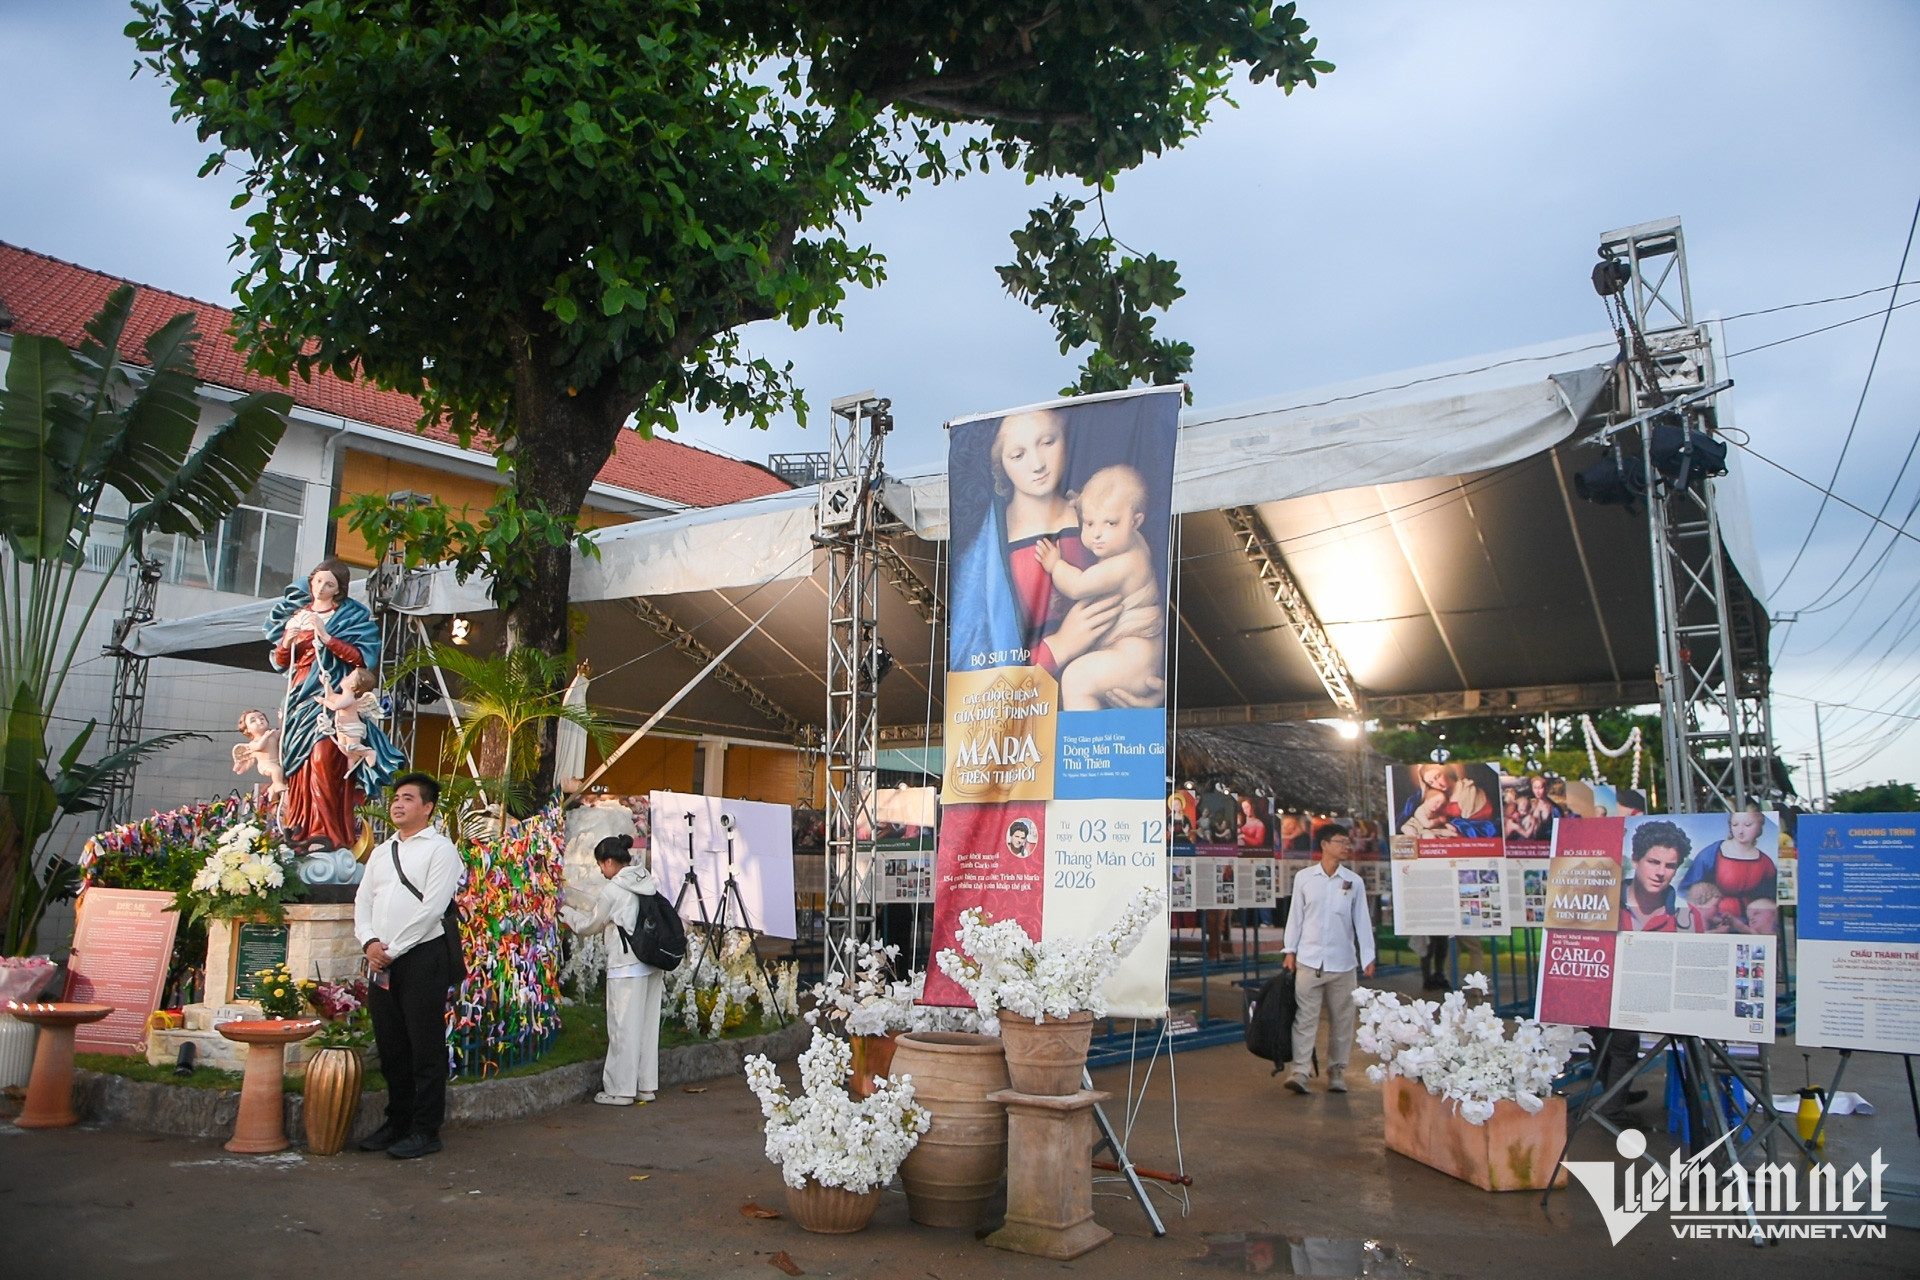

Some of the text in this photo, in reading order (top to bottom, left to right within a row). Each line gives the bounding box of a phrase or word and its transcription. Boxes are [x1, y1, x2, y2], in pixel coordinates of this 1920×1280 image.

[970, 652, 986, 666] BỘ
[1010, 648, 1031, 661] TẬP
[1063, 742, 1165, 758] Dòng Mến Thánh Giá
[1062, 758, 1081, 770] Thủ
[960, 770, 991, 785] TRÊN
[1079, 819, 1107, 843] 03
[1114, 820, 1130, 830] đến
[1141, 820, 1163, 844] 12
[1055, 850, 1155, 869] Tháng Mân Côi
[1054, 870, 1096, 889] 2026
[1552, 893, 1611, 911] MARIA
[1551, 947, 1606, 963] CARLO
[1548, 961, 1610, 978] ACUTIS
